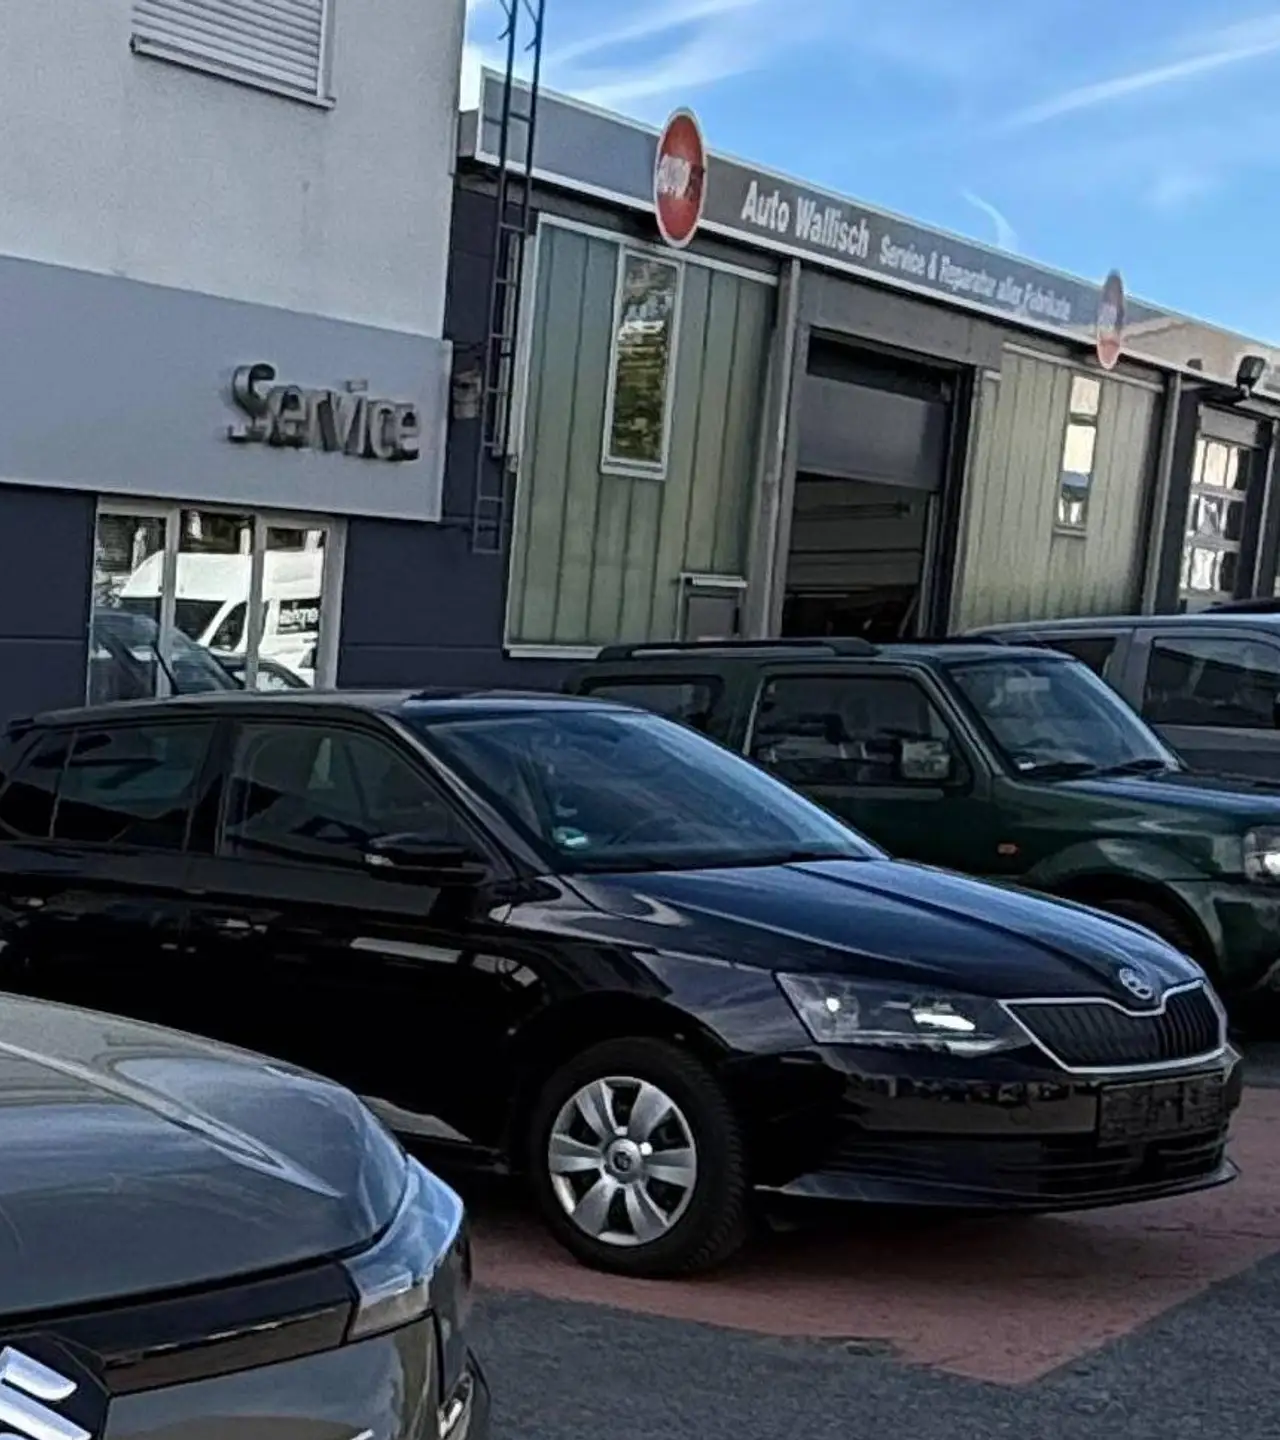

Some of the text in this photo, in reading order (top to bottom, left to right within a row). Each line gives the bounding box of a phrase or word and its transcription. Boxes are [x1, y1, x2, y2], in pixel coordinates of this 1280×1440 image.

[740, 180, 790, 233] Auto
[795, 196, 870, 260] Wallisch
[879, 234, 925, 277] Service
[226, 362, 422, 462] Service
